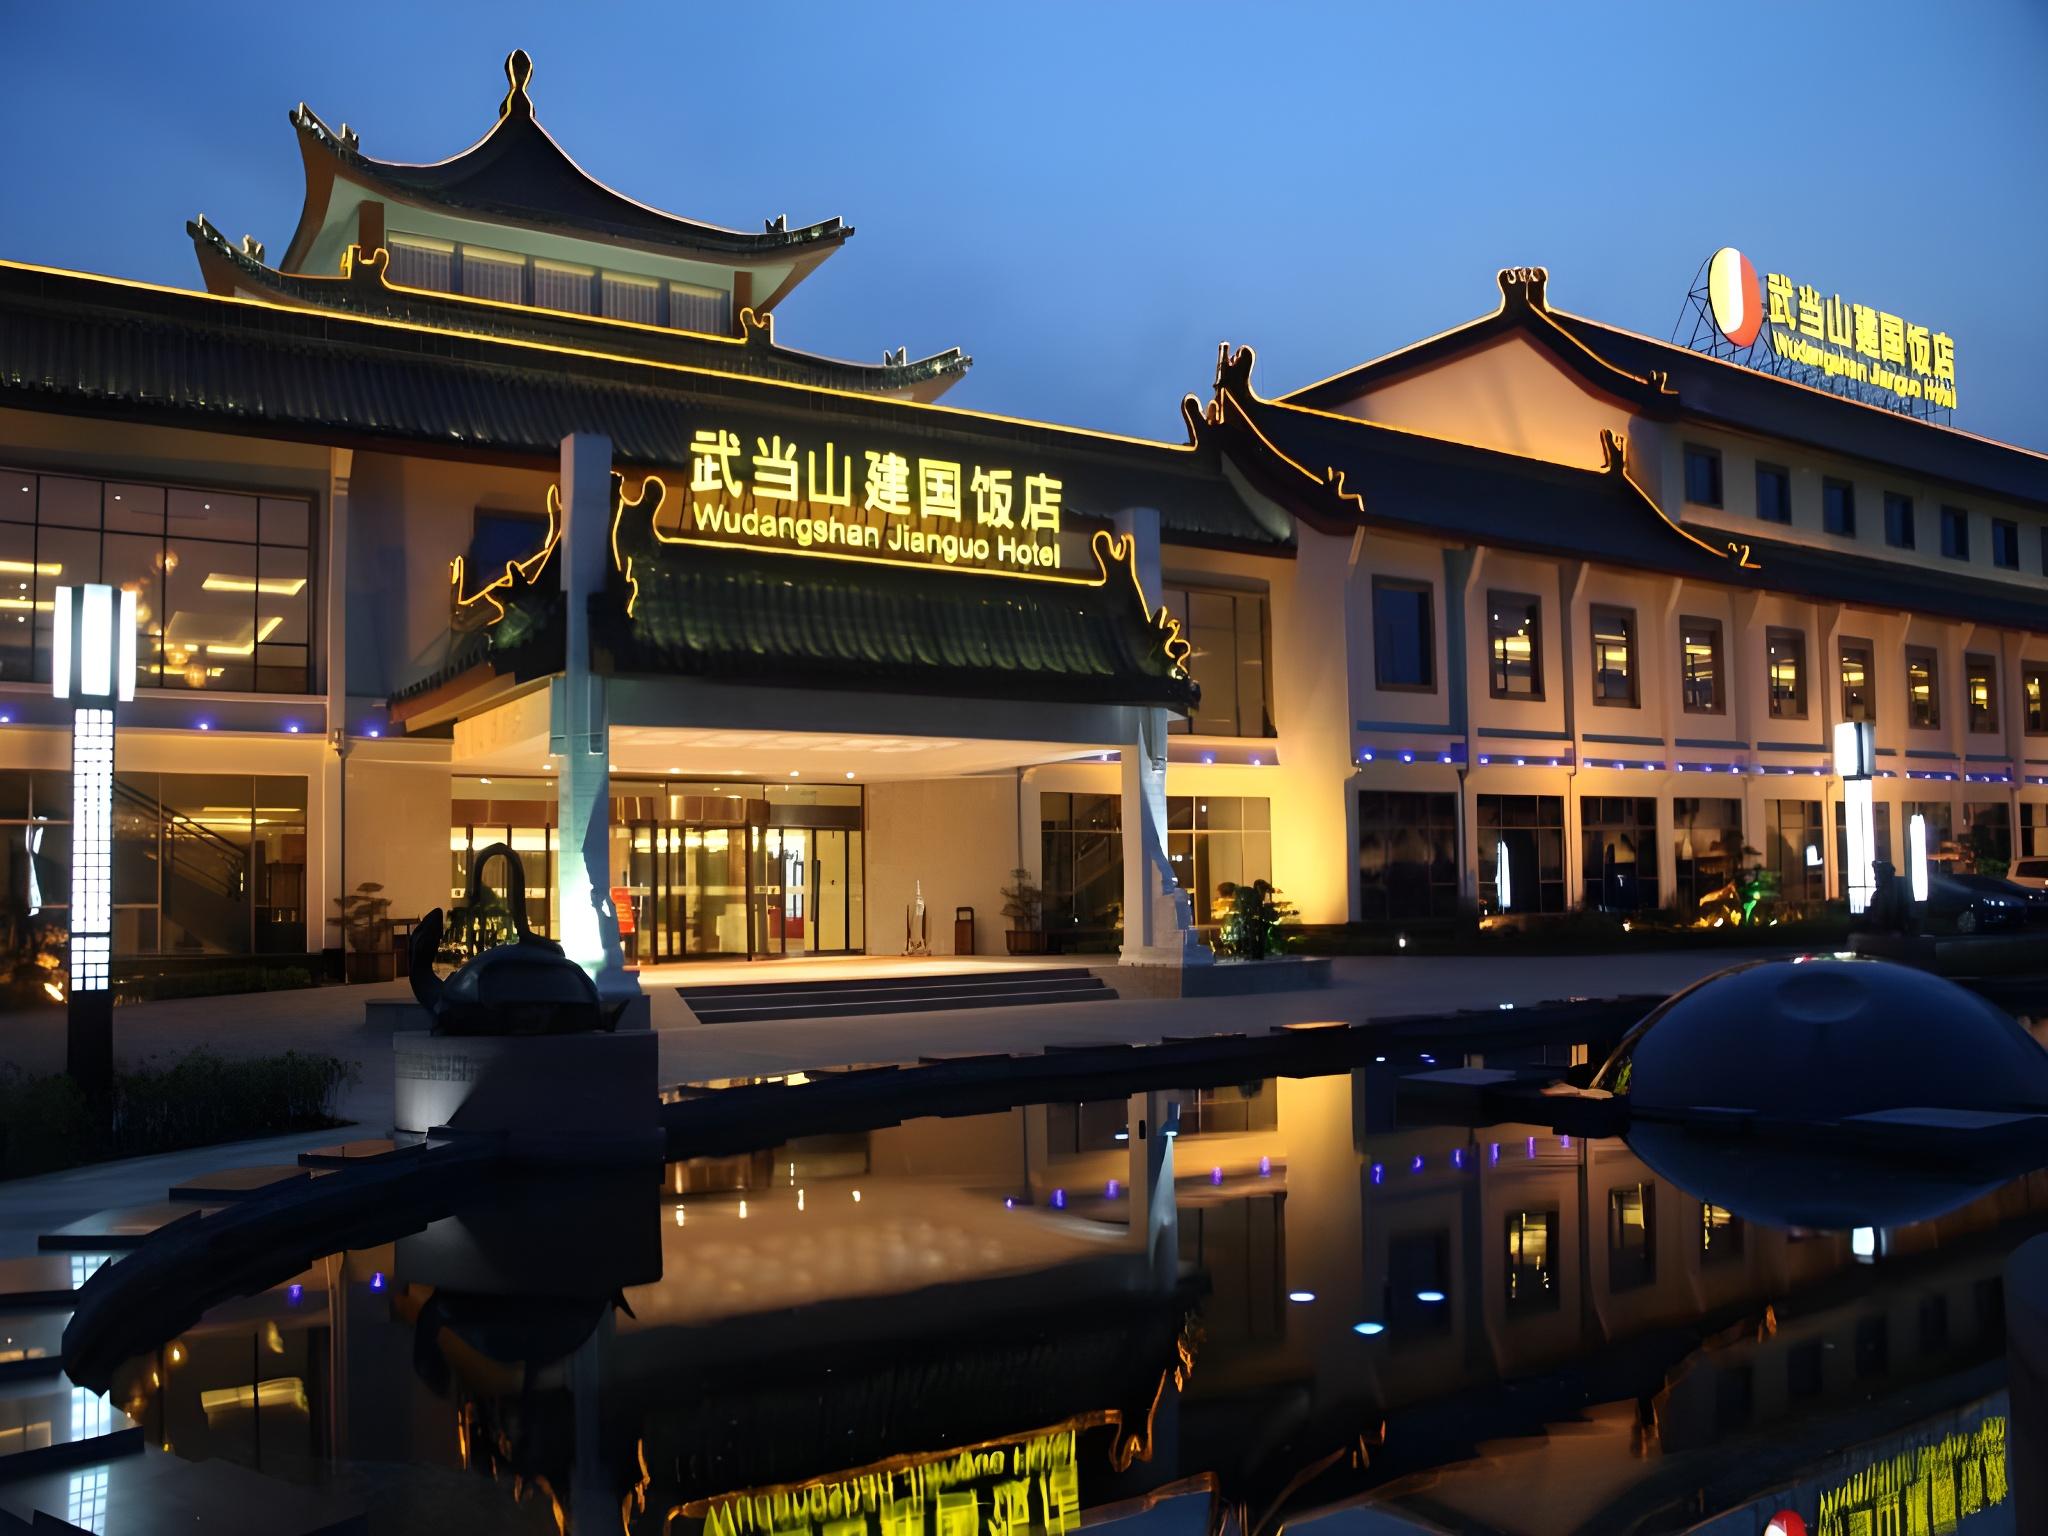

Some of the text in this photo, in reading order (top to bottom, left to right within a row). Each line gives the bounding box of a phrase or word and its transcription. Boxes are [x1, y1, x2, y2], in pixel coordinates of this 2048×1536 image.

[1767, 273, 1955, 382] 武当山建国饭店
[690, 429, 1063, 534] 武当山建国饭店
[693, 502, 1061, 569] Wudangshan Jianguo Hotel
